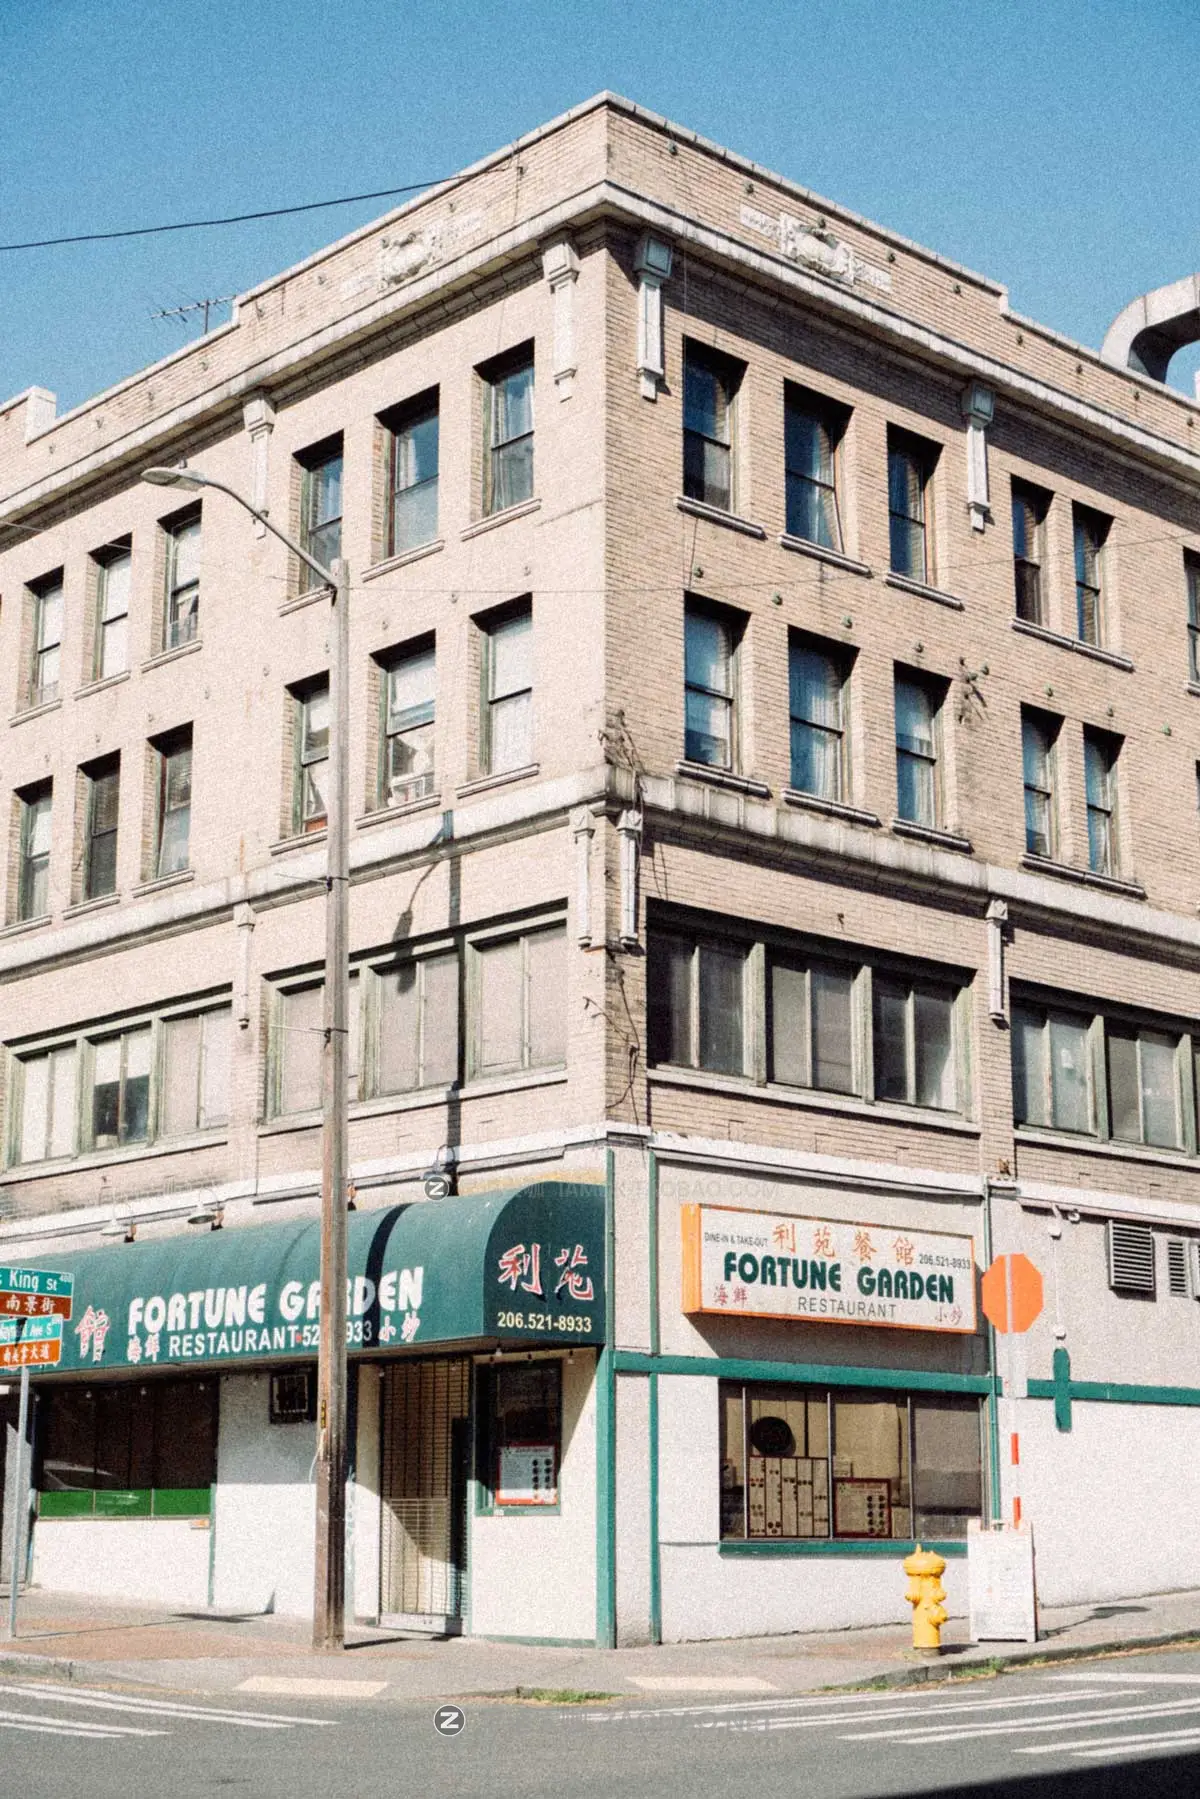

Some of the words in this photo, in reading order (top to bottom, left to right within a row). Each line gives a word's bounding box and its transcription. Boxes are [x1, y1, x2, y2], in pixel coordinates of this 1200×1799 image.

[704, 1232, 729, 1243] DINE-IN
[731, 1235, 736, 1245] &
[737, 1235, 768, 1247] TAKE-OUT
[772, 1223, 915, 1266] 利苑餐館
[498, 1243, 594, 1300] 利苑
[919, 1253, 970, 1269] 206.521-8933
[9, 1269, 39, 1293] King
[46, 1278, 58, 1291] St
[724, 1251, 841, 1292] FORTUNE
[857, 1266, 954, 1304] GARDEN
[128, 1283, 266, 1335] FORTUNE
[798, 1296, 896, 1318] RESTAURANT
[46, 1322, 52, 1336] S
[497, 1311, 592, 1333] 206.521-8933
[169, 1324, 299, 1357] RESTAURANT
